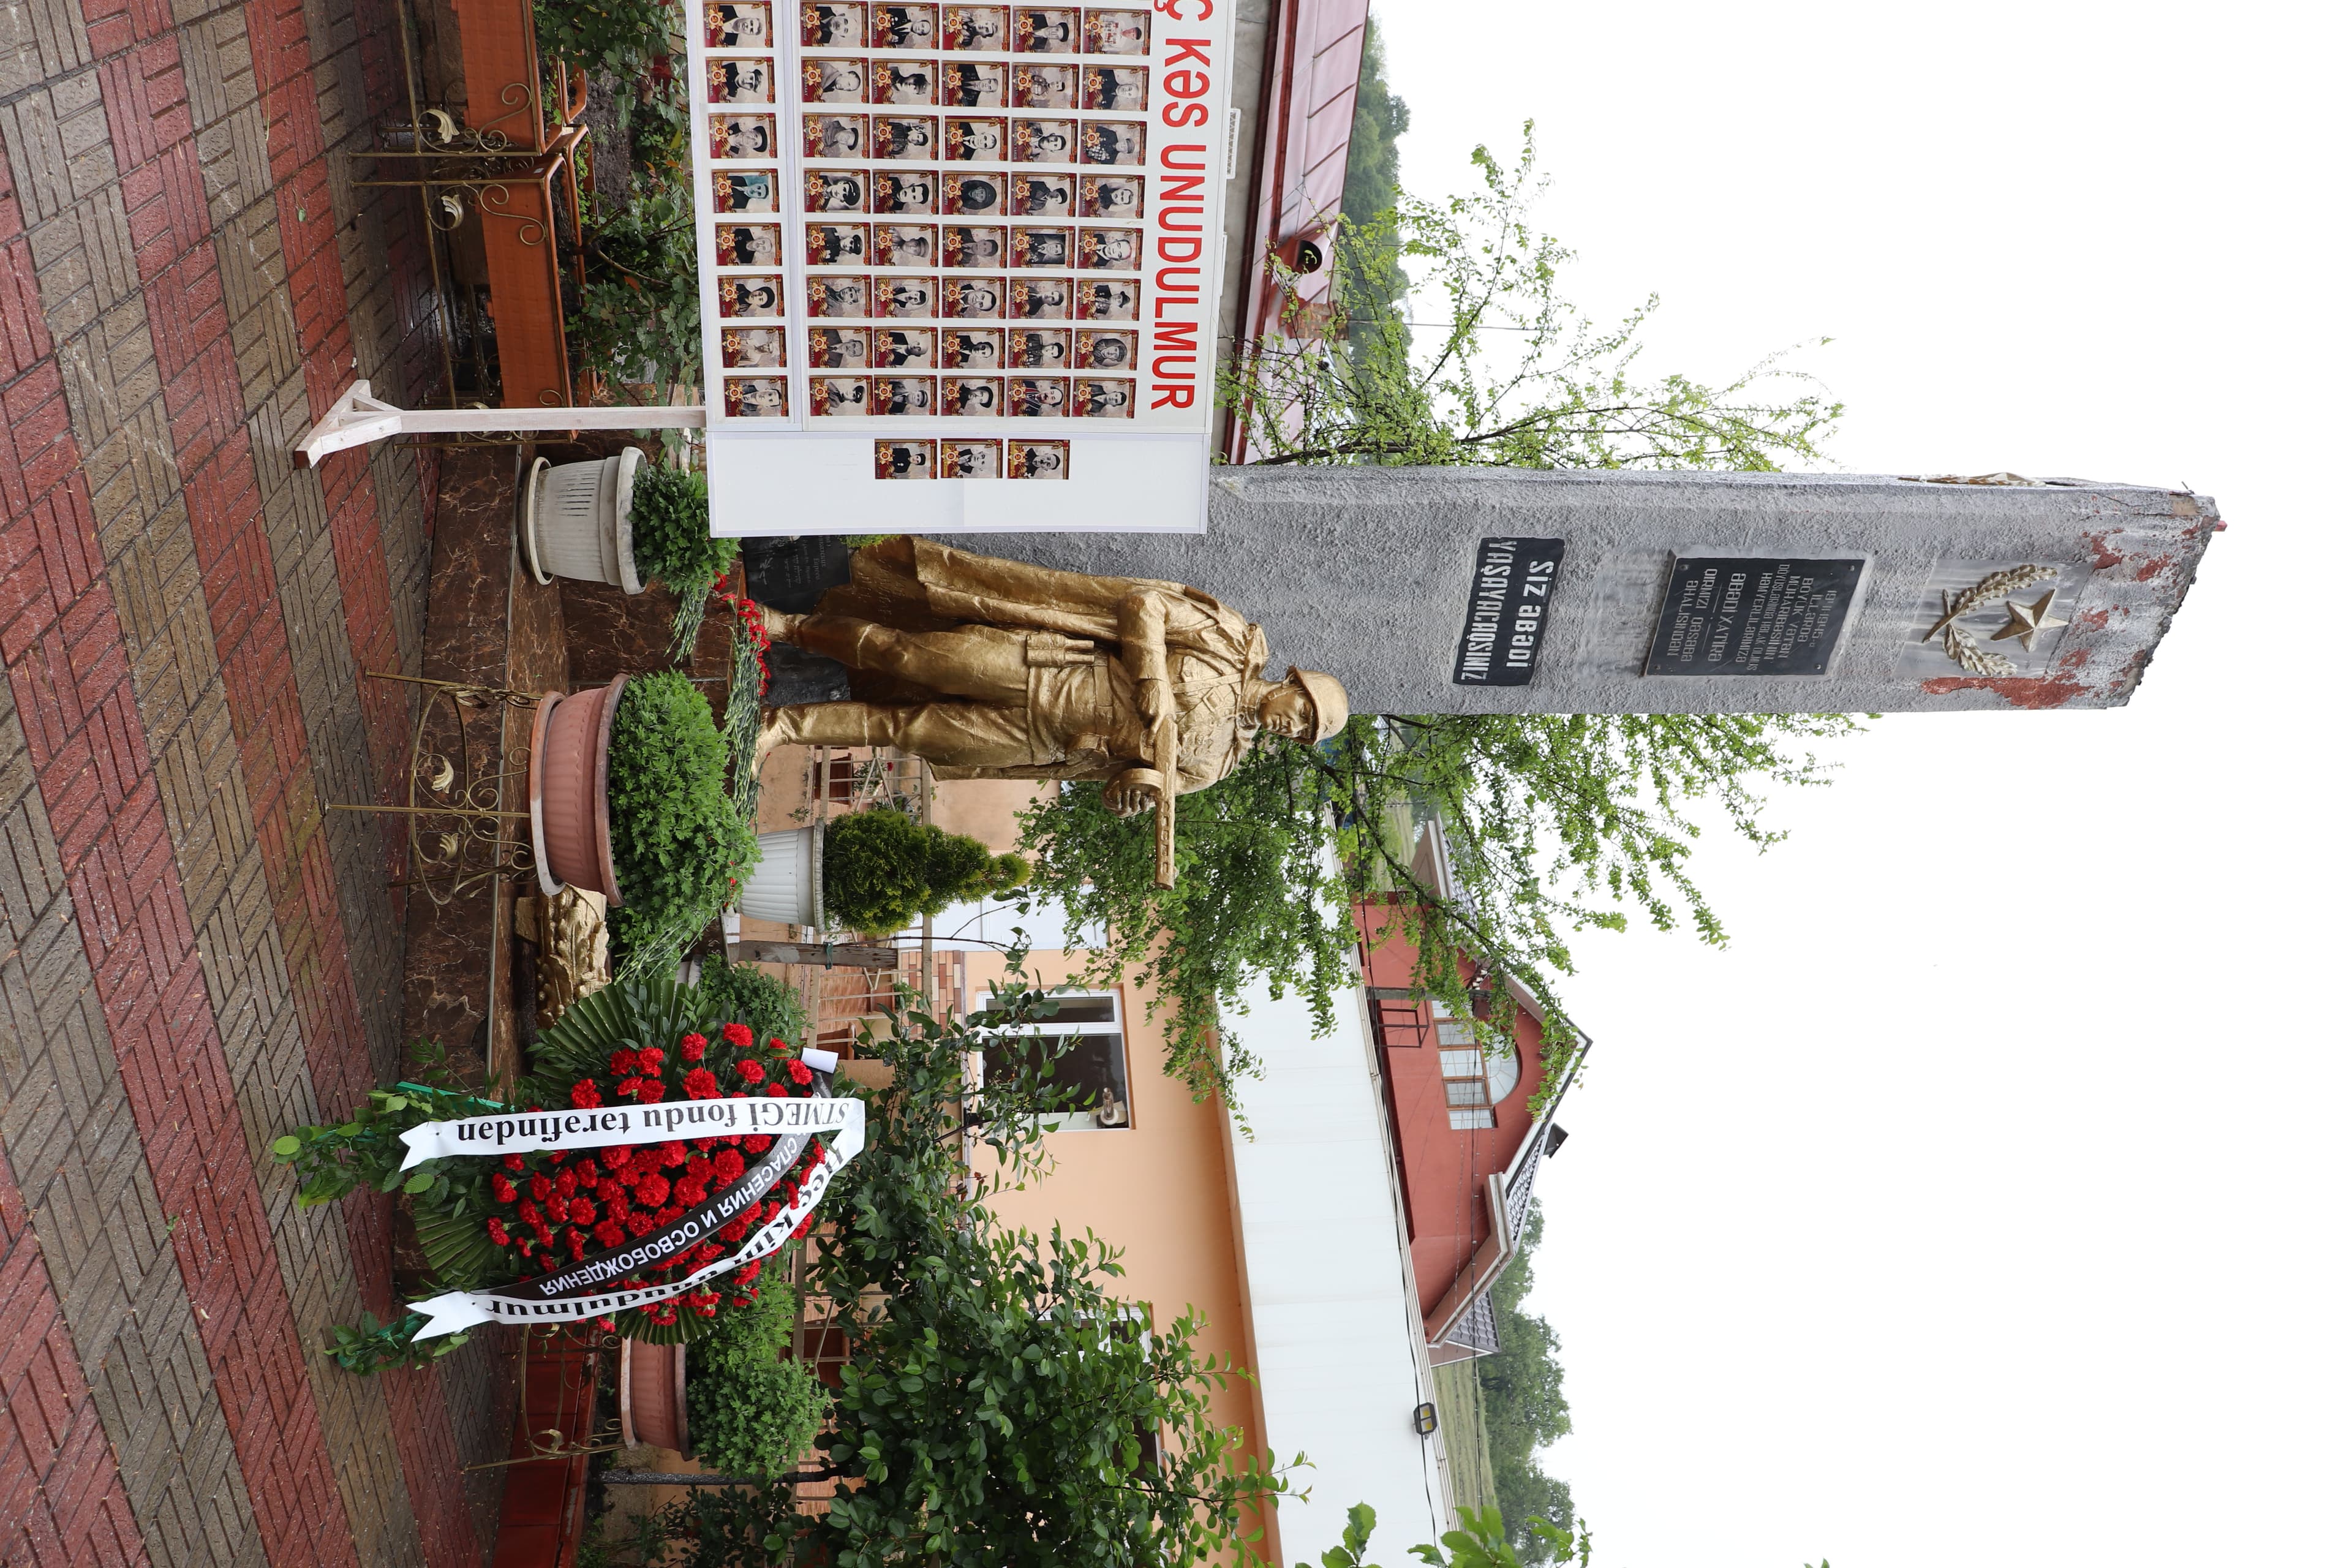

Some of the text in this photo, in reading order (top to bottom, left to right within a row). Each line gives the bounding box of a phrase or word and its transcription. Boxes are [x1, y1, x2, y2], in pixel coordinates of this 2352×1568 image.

[1163, 39, 1211, 127] KƏS
[1151, 145, 1207, 410] UNUDULMUR
[1461, 540, 1517, 680] YAŞAYACAQSINIZ
[1506, 560, 1555, 667] SİZ ƏBƏDİ
[1695, 568, 1718, 608] QIRMIZI
[1708, 573, 1746, 662] ƏBƏDİ XATİRƏ
[1777, 578, 1814, 659] BÖYÜK VƏTƏN
[457, 1102, 850, 1145] STMEGİ fondu tərəfindən
[538, 1137, 797, 1296] СПАСЕНИЯ И ОСВОБОЖДЕНИЯ
